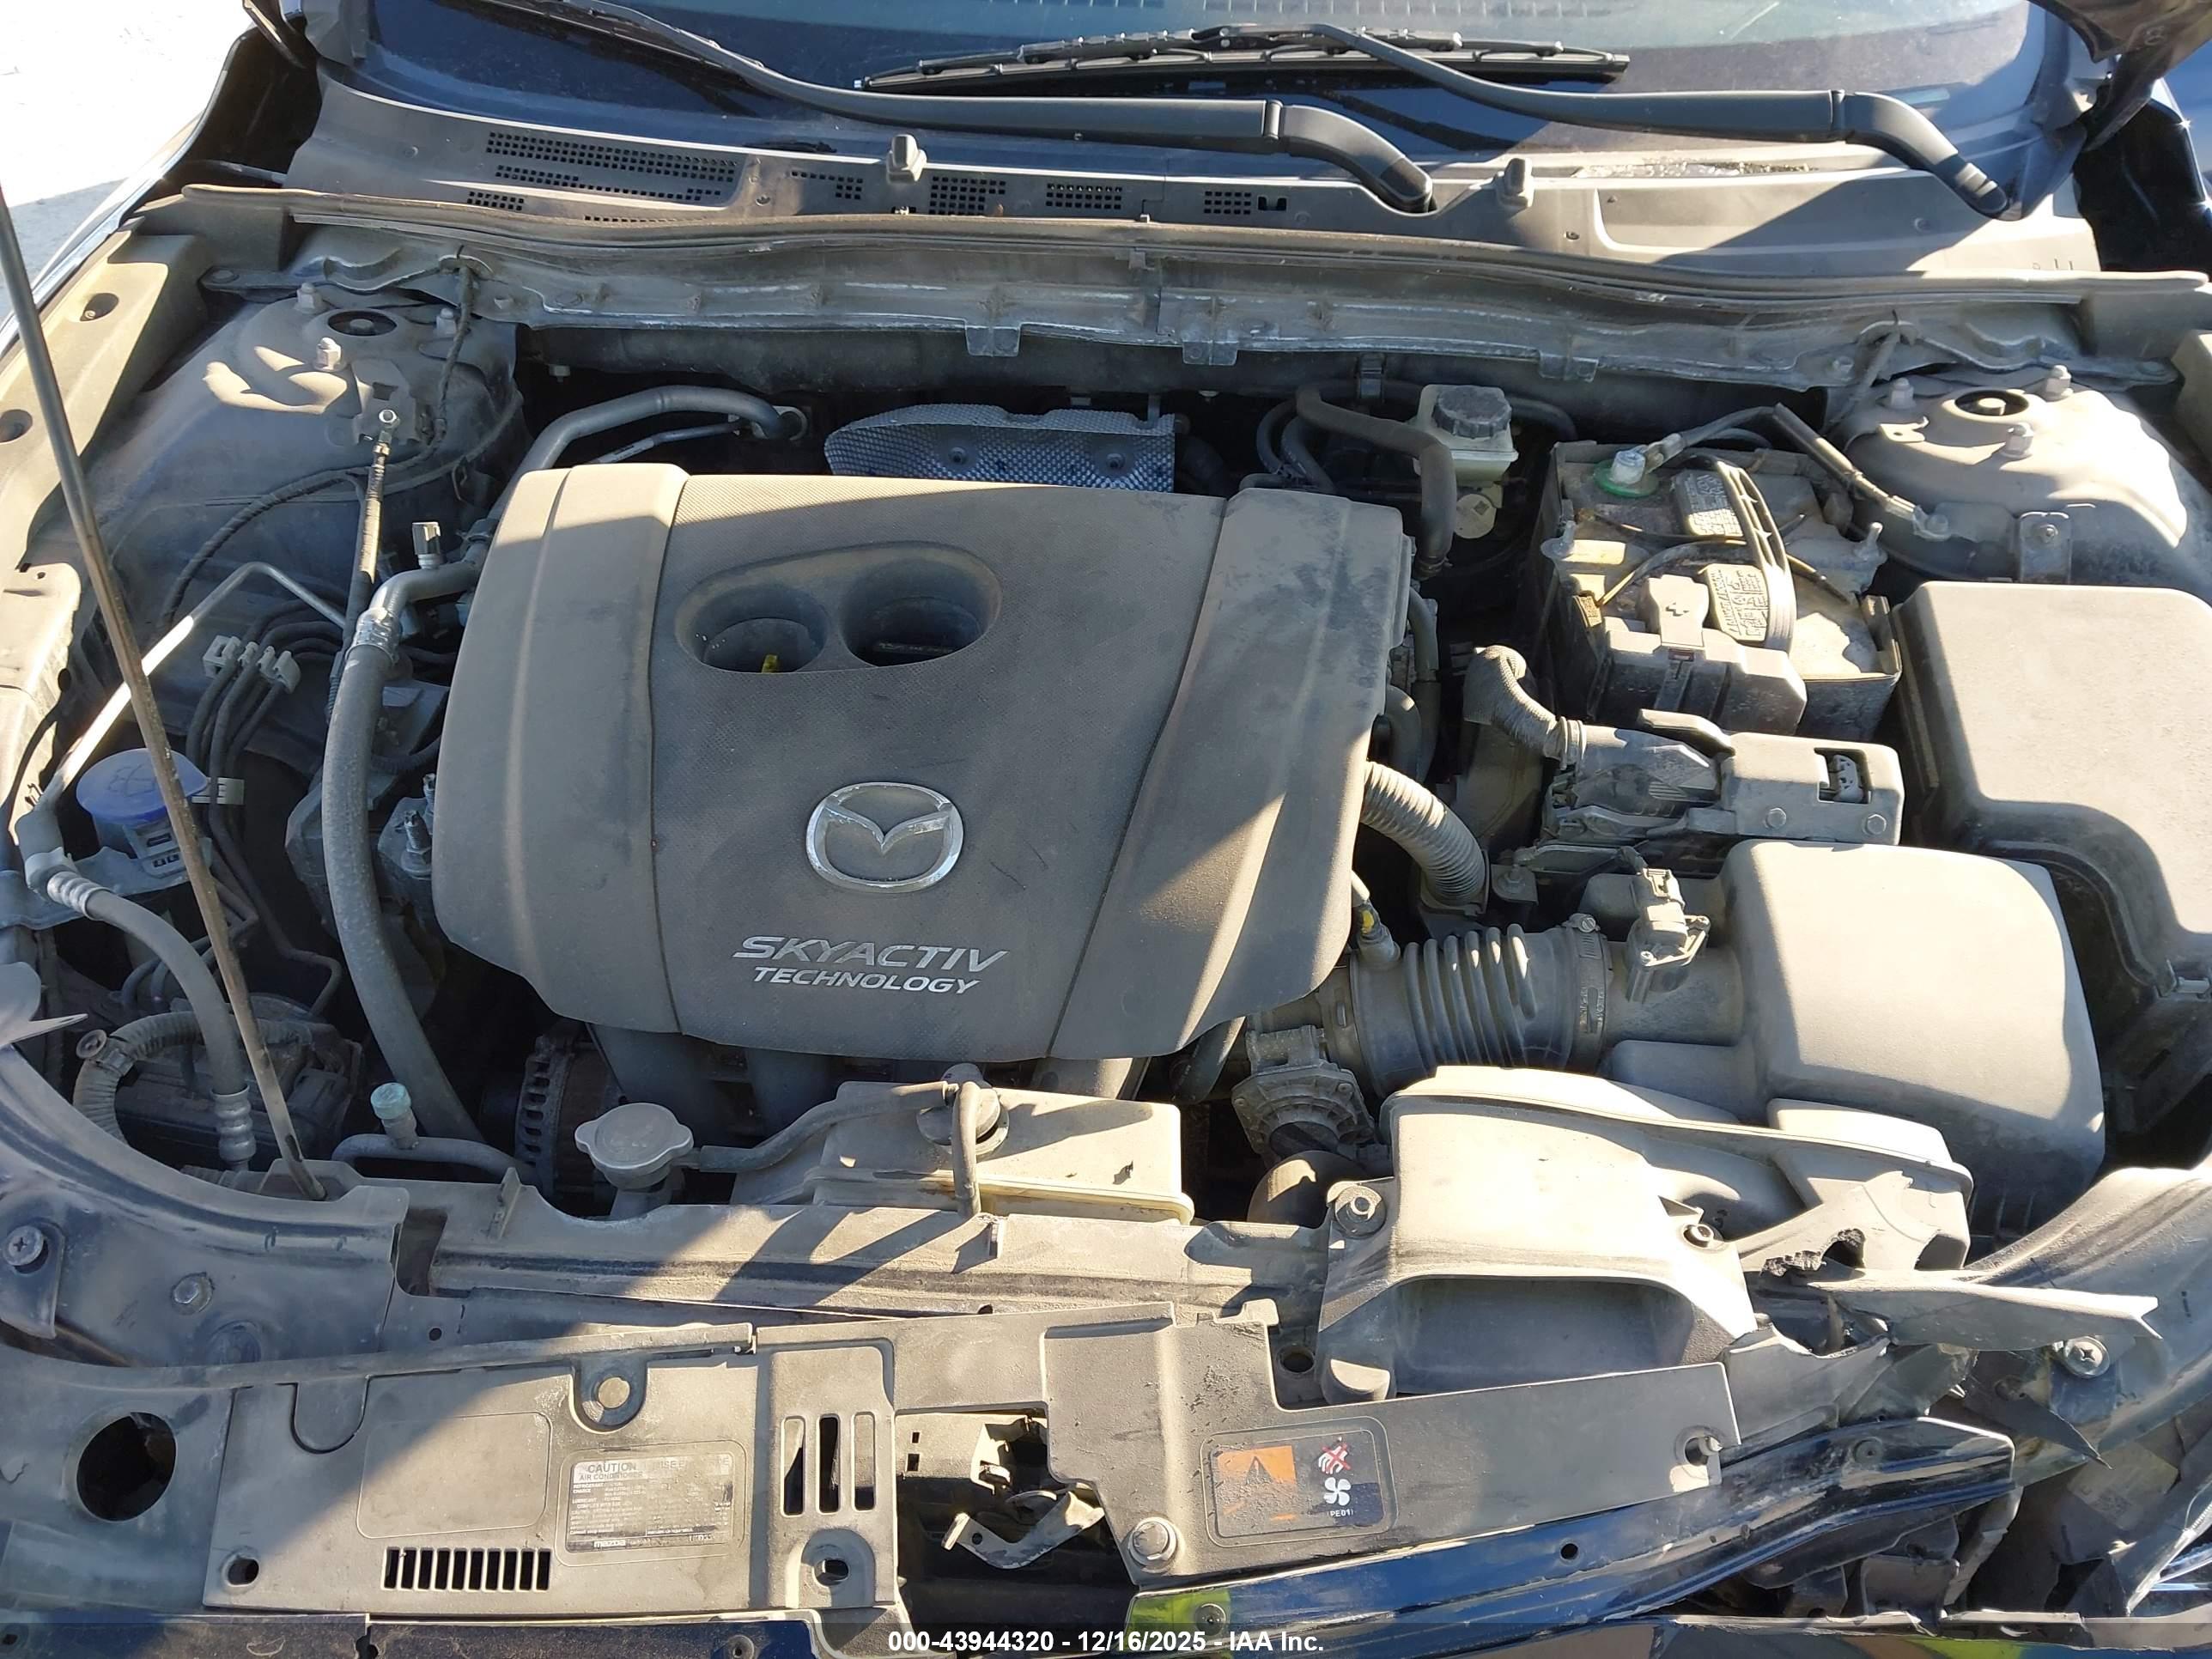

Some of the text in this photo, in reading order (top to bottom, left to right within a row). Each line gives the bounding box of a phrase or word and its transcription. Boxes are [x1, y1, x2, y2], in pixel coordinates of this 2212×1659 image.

[732, 934, 1009, 973] SKYACTIV
[753, 965, 982, 995] TECHNOLOGY
[587, 1462, 636, 1474] CAUTION
